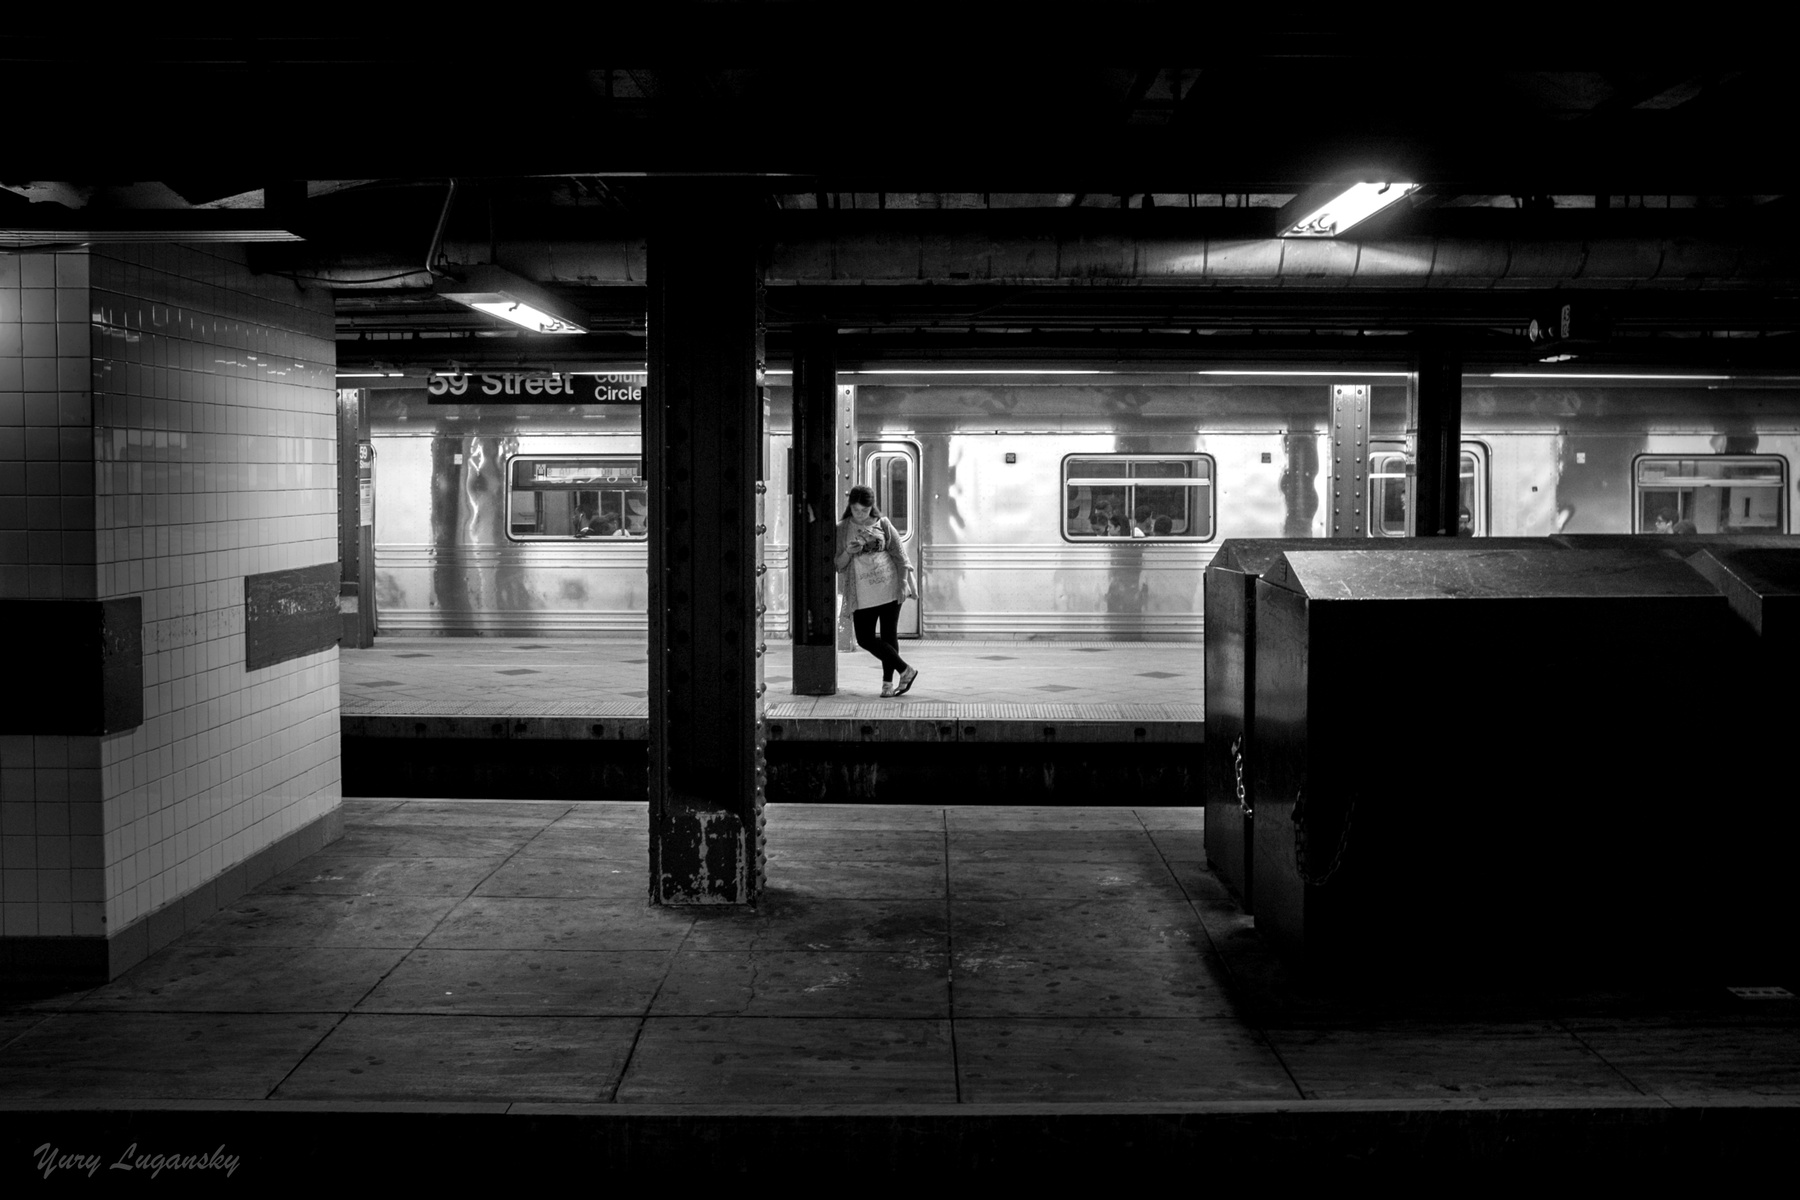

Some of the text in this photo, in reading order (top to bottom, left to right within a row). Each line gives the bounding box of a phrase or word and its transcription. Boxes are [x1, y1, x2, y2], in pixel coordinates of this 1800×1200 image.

[429, 373, 574, 395] 59 Street
[594, 386, 642, 401] Circle
